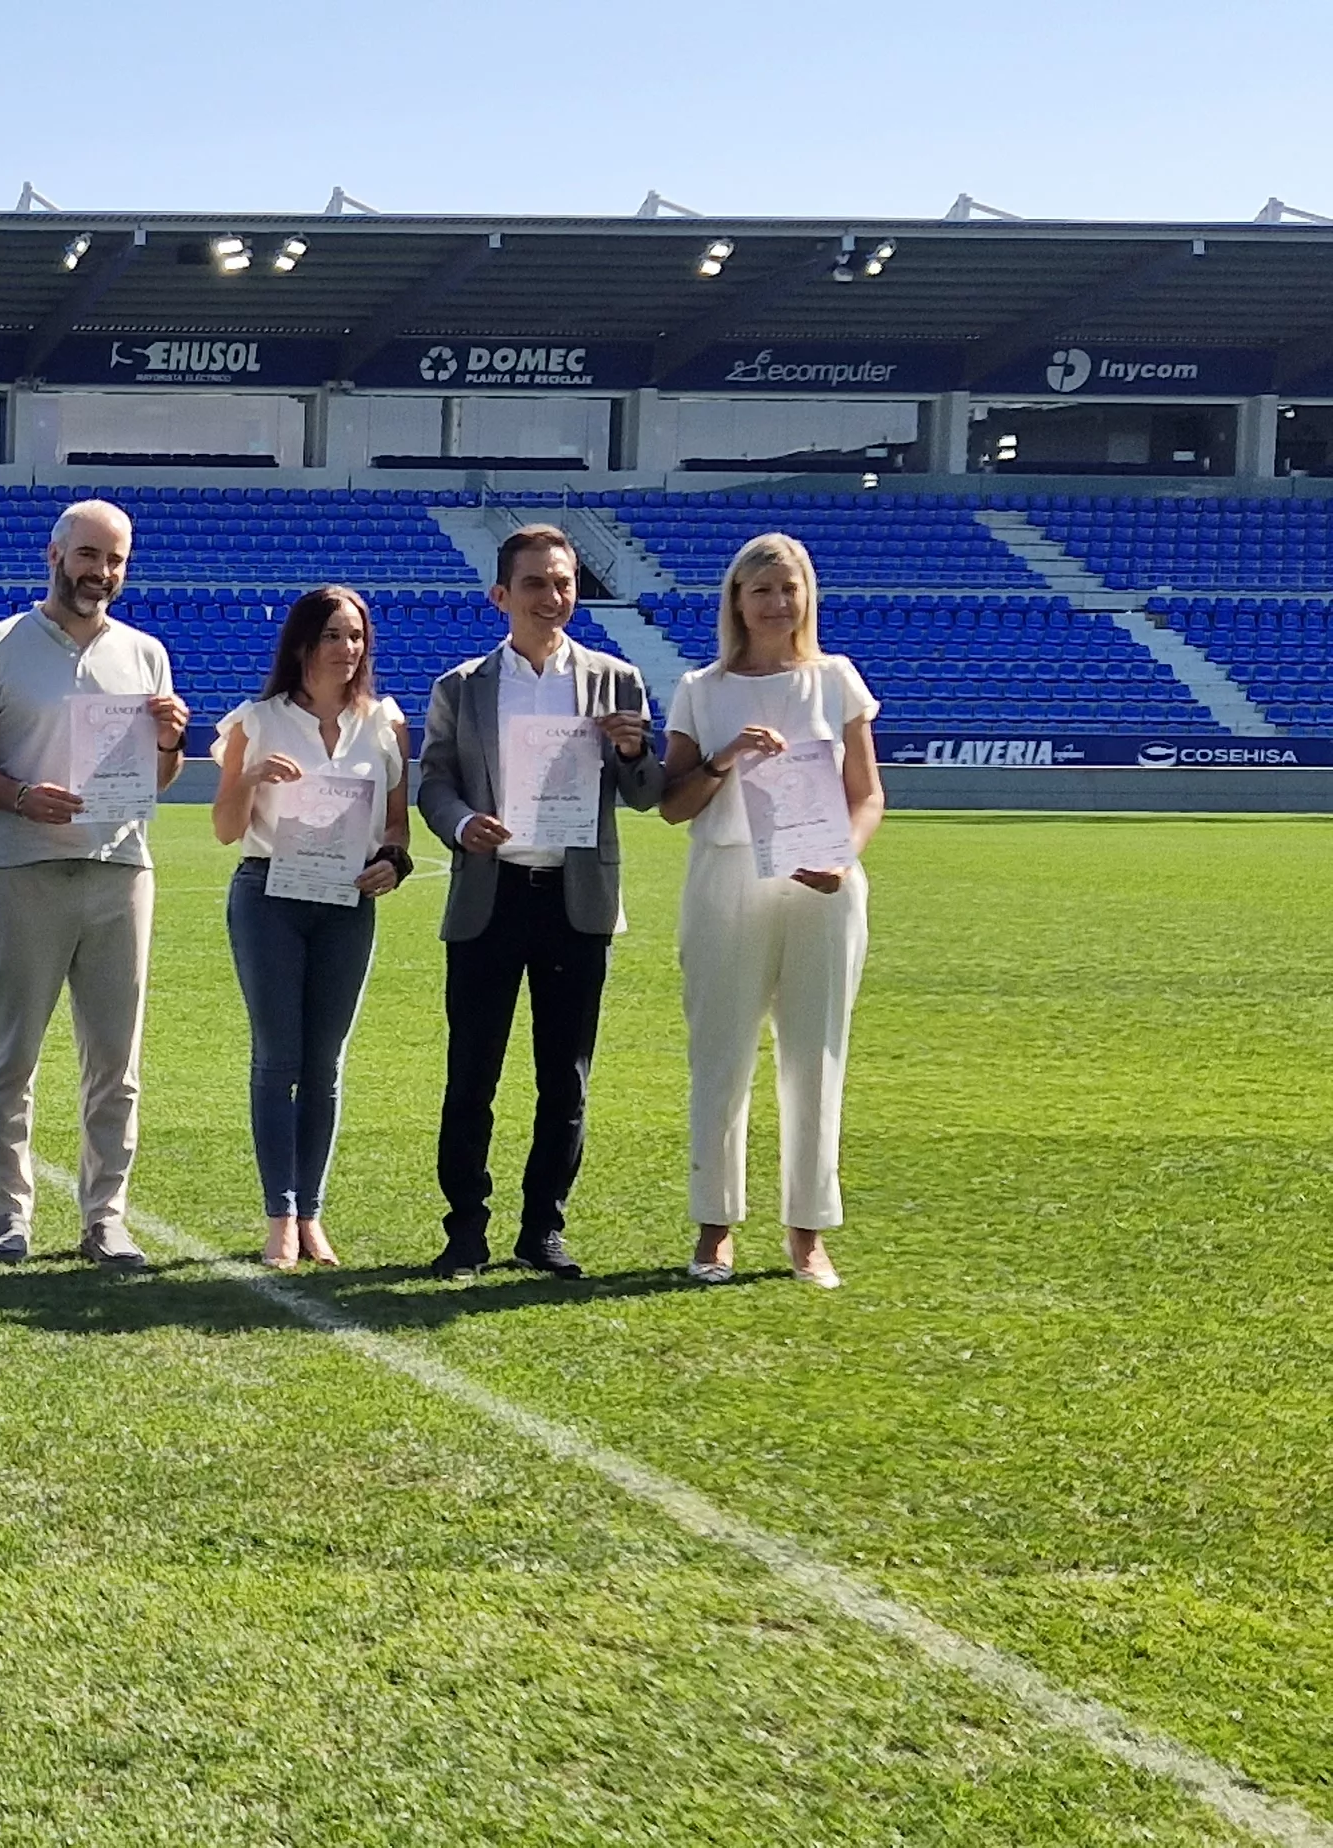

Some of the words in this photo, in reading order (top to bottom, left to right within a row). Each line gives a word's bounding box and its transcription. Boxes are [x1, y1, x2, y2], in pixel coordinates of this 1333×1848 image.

[145, 341, 261, 372] EHUSOL
[467, 347, 587, 373] DOMEC
[465, 373, 511, 383] PLANTA
[514, 374, 531, 384] DE
[534, 374, 593, 385] RECICLAJE
[767, 360, 897, 387] ecomputer
[1099, 359, 1198, 382] Inycom
[925, 740, 1053, 765] CLAVERIA
[1180, 748, 1298, 763] COSEHISA
